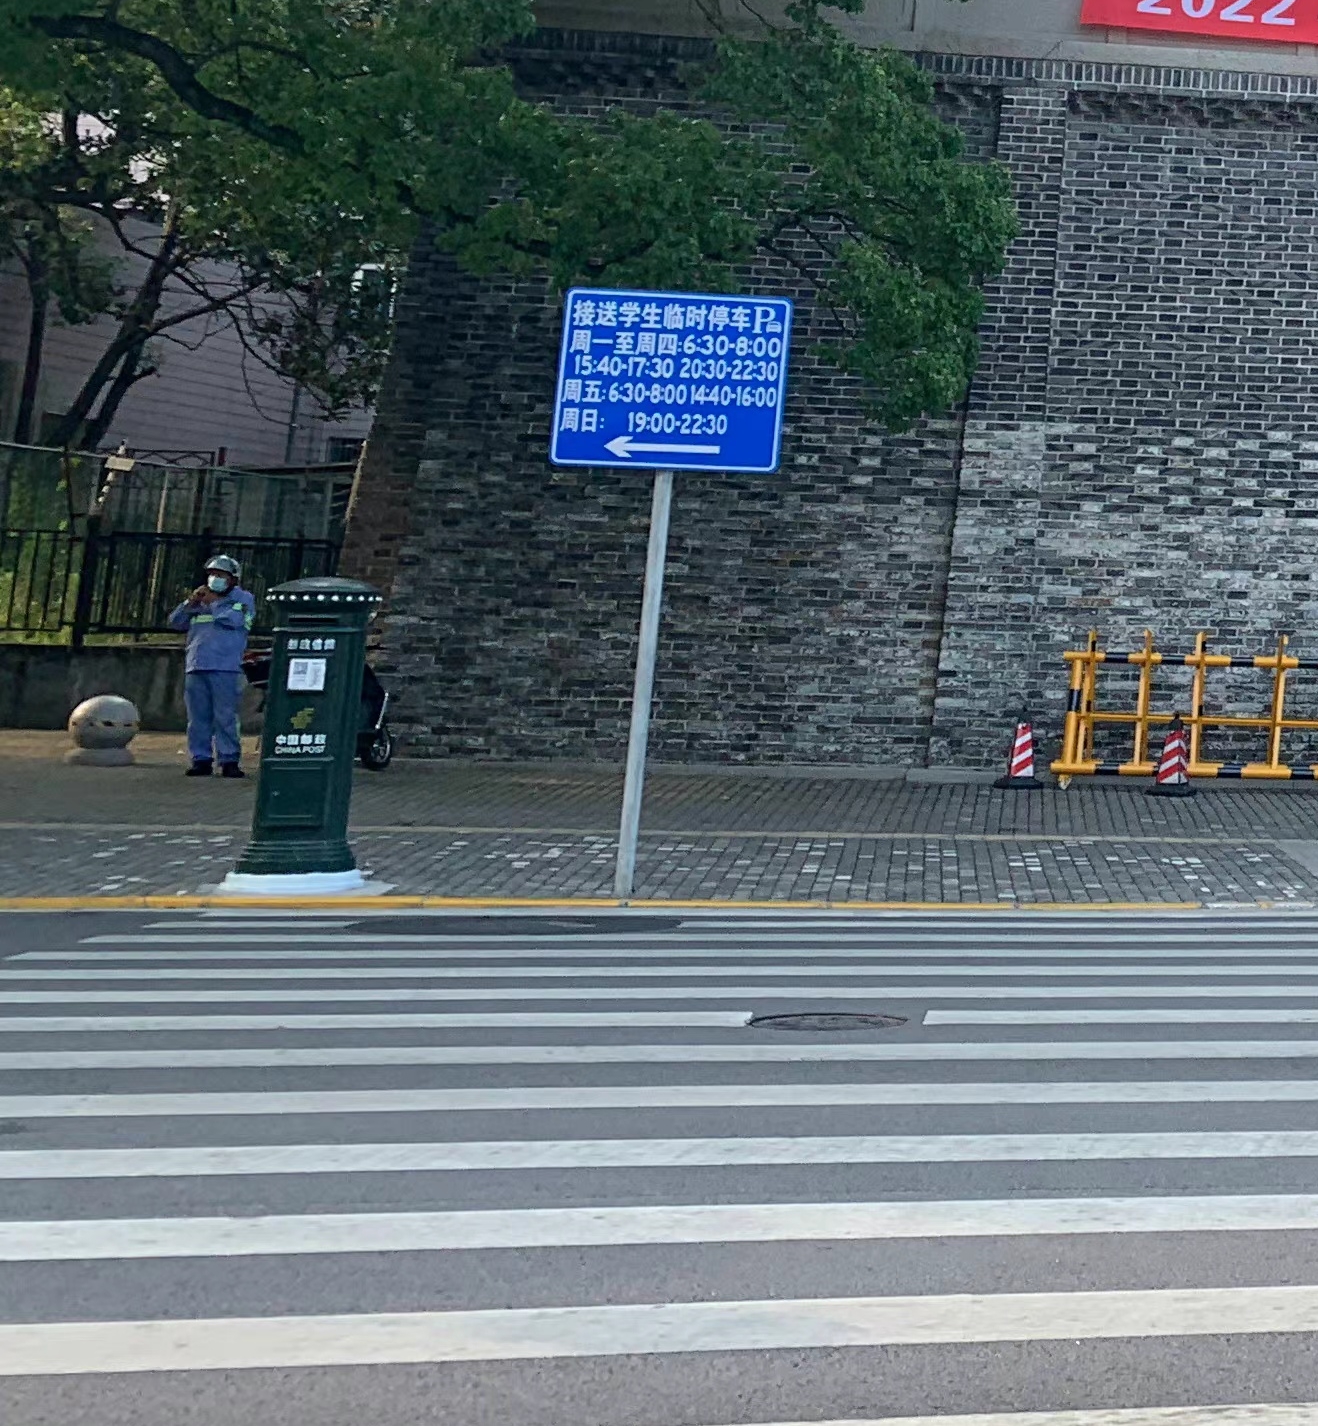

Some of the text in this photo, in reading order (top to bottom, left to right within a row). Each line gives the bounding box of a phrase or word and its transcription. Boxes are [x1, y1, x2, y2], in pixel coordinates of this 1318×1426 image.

[574, 354, 778, 381] 15:40-17:30 20:30-22:30
[627, 411, 728, 435] 19:00-22:30
[302, 745, 326, 754] POST
